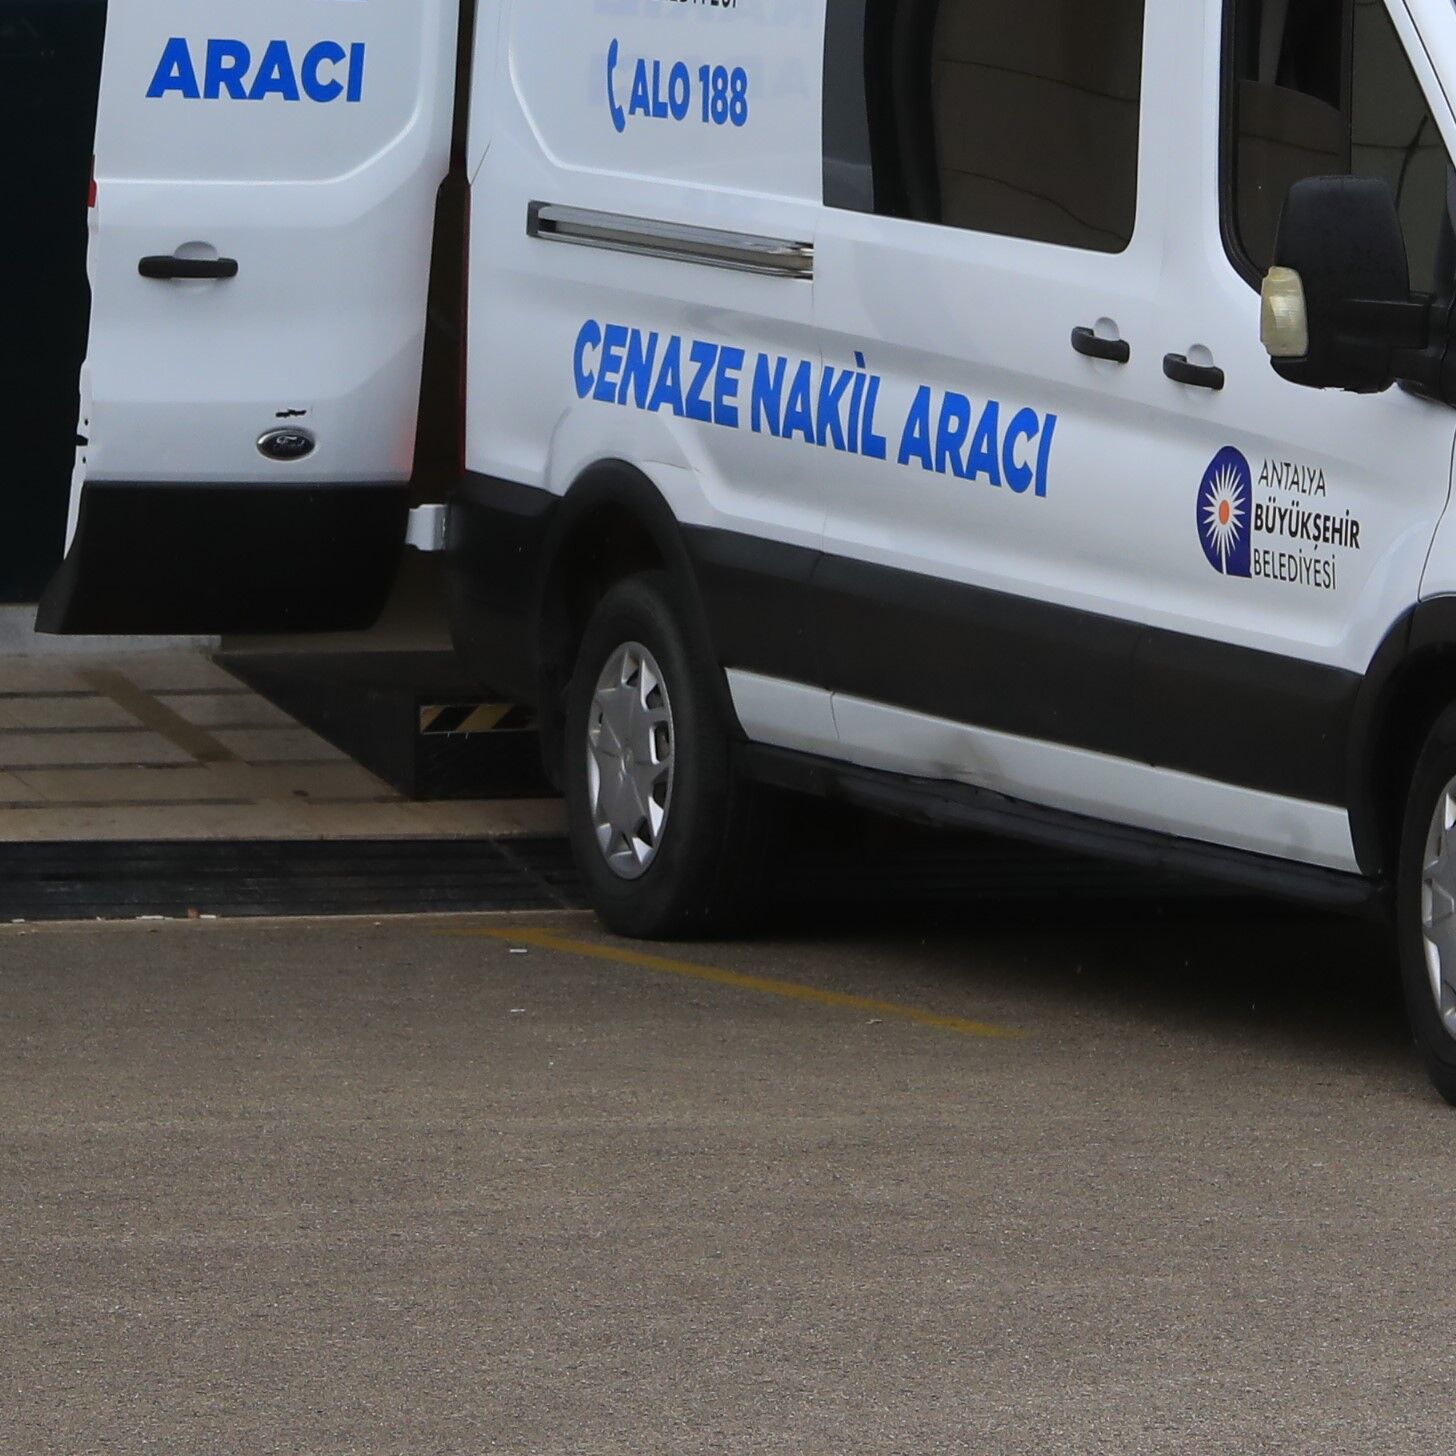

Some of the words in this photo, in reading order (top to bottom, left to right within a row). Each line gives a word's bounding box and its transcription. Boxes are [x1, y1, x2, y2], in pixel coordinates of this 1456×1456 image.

[145, 38, 365, 102] ARACI
[629, 58, 690, 121] ALO
[698, 64, 748, 127] 188
[573, 319, 745, 428] CENAZE
[751, 351, 887, 461] NAKİL
[898, 385, 1057, 498] ARACI
[1258, 458, 1326, 497] ANTALYA
[1254, 496, 1360, 550] BÜYÜKŞEHİR
[1253, 548, 1337, 590] BELEDİYESİ
